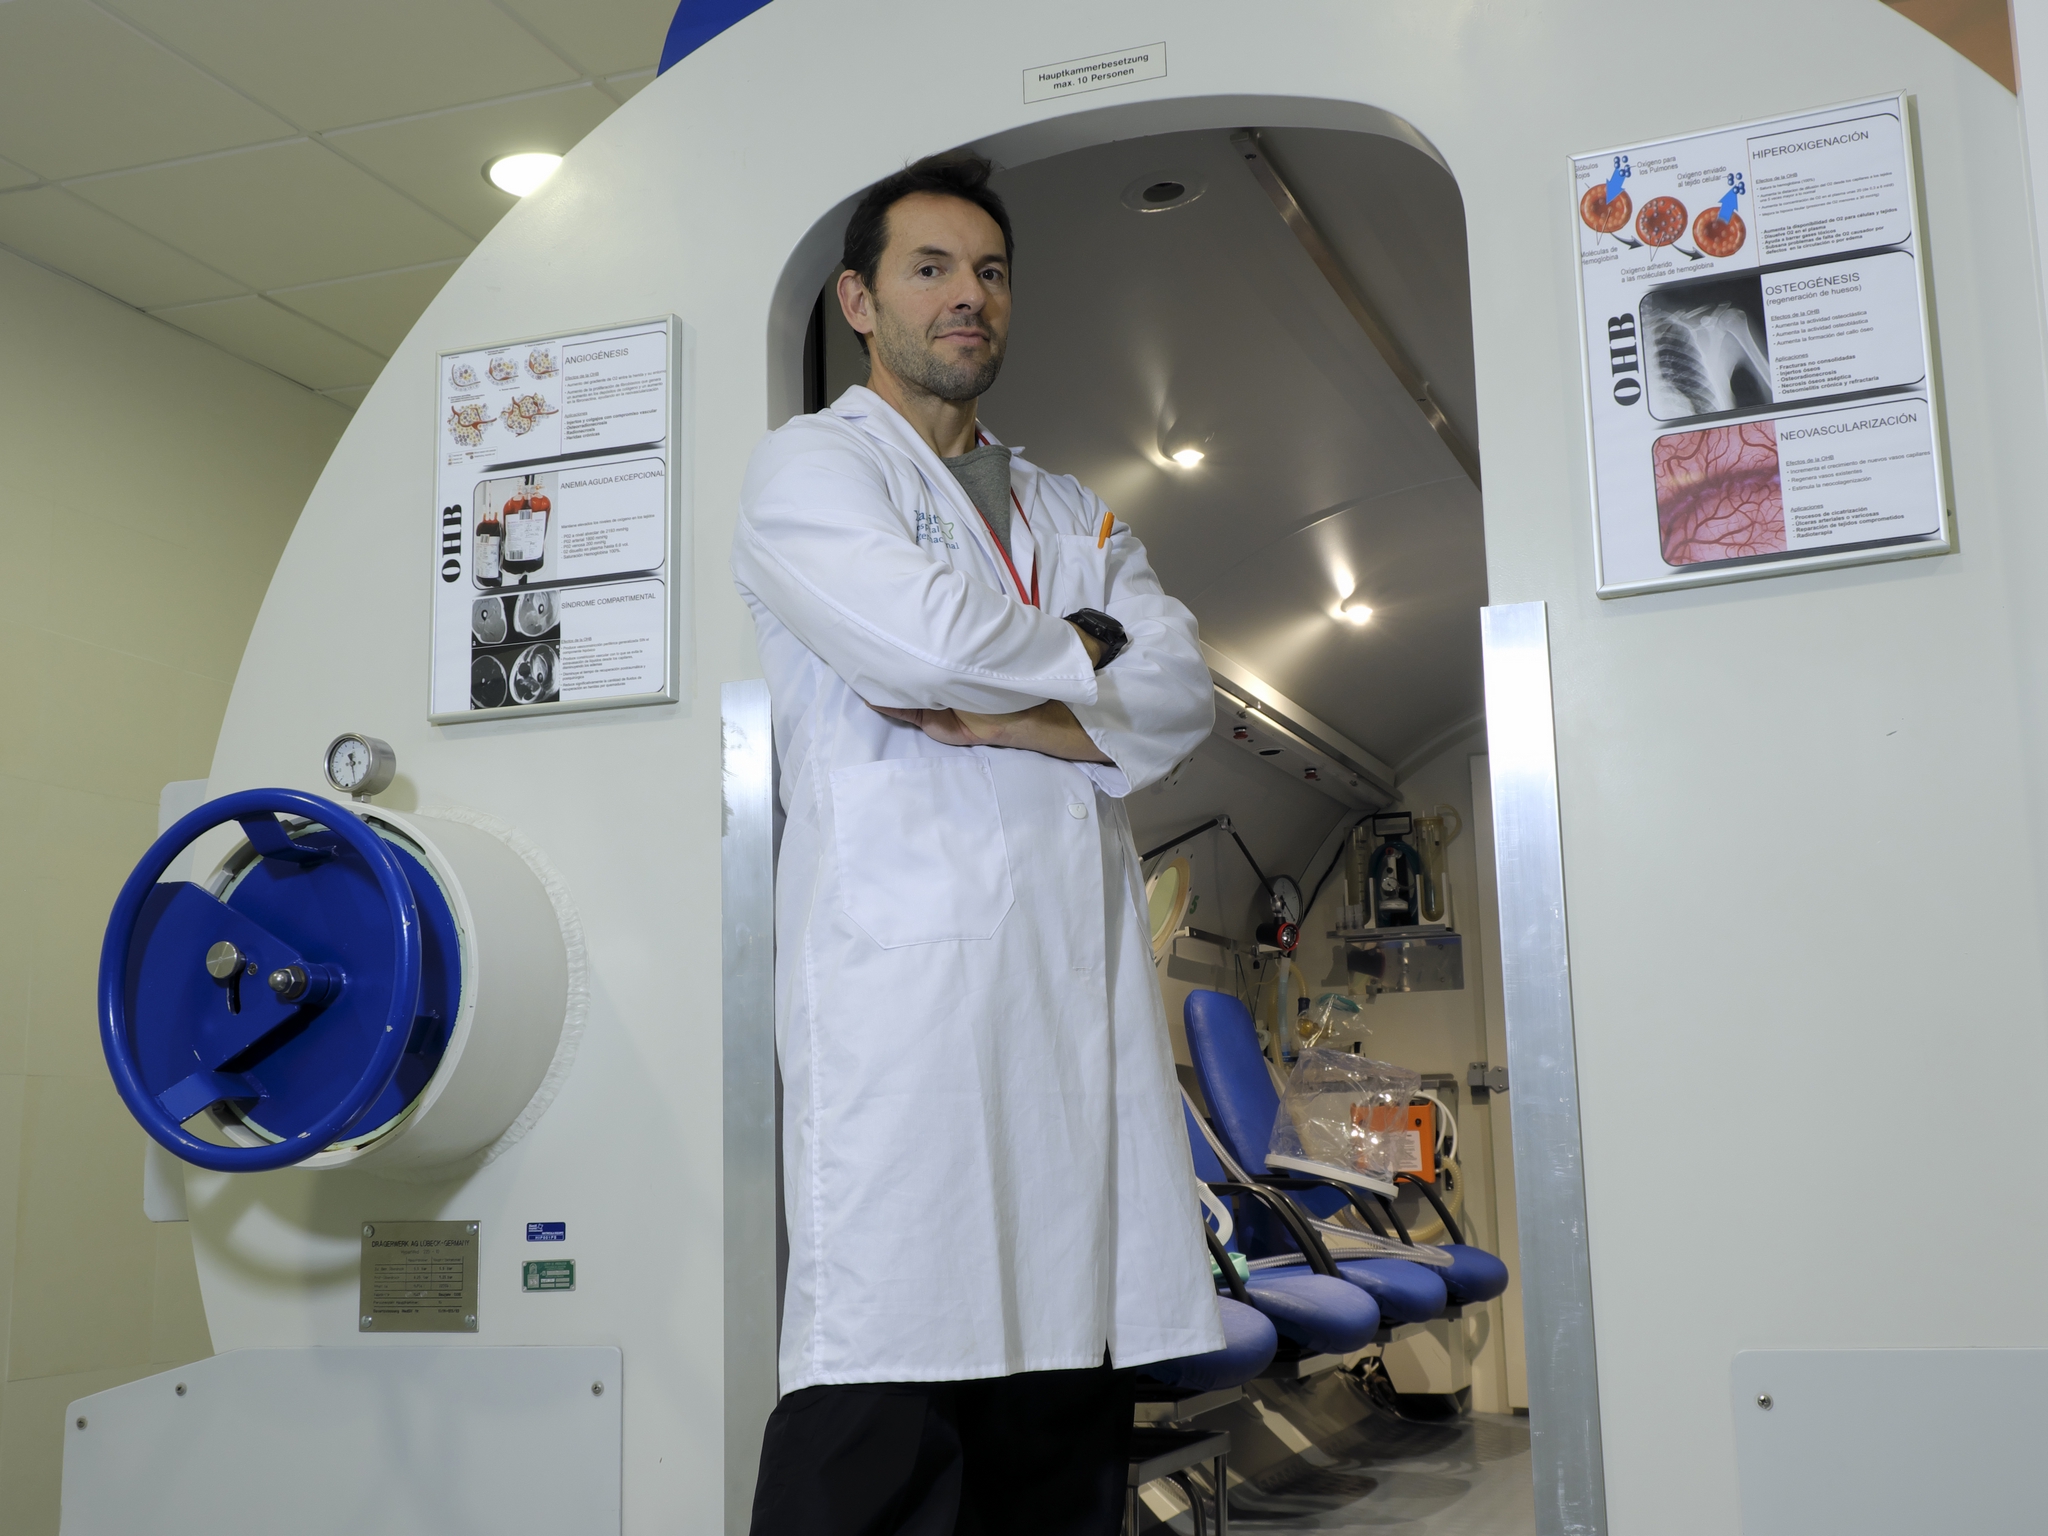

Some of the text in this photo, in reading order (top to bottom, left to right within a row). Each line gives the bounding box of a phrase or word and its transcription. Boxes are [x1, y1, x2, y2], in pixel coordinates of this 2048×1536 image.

[1038, 54, 1148, 81] Hauptkammerbesetzung
[1053, 80, 1075, 89] max.
[1091, 69, 1134, 81] Personen
[1752, 131, 1868, 159] HIPEROXIGENACIÓN
[1637, 160, 1662, 168] Oxígeno
[1650, 164, 1678, 172] Pulmones
[1677, 166, 1727, 180] Oxígeno enviado
[1621, 262, 1672, 275] Oxígeno adherido
[1637, 271, 1666, 279] moléculas
[1676, 263, 1714, 272] hemoglobina
[1766, 273, 1860, 296] OSTEOGÉNESIS
[1766, 293, 1818, 305] (regeneración
[1831, 285, 1862, 294] huesos)
[1832, 311, 1867, 320] osteoclástica
[1832, 320, 1868, 328] osteoblástica
[565, 348, 629, 364] ANGIOGÉNESIS
[1608, 313, 1641, 406] OHB
[1775, 354, 1808, 362] Aplicaciones
[1817, 355, 1856, 364] consolidadas
[1780, 370, 1802, 378] Injertos
[1781, 371, 1837, 381] Osteoradionecrosis
[1827, 375, 1851, 384] aséptica
[1782, 386, 1819, 394] Osteomielitis
[1780, 413, 1917, 441] NEOVASCULARIZACIÓN
[614, 470, 664, 482] EXCEPCIONAL
[1822, 477, 1872, 486] neocolagenización
[1795, 518, 1817, 526] Úlceras
[1796, 525, 1828, 534] Reparación
[1859, 515, 1904, 524] comprometidos
[442, 504, 462, 583] OHB
[561, 594, 655, 609] SÍNDROME COMPARTIMENTAL
[1189, 895, 1199, 914] 5
